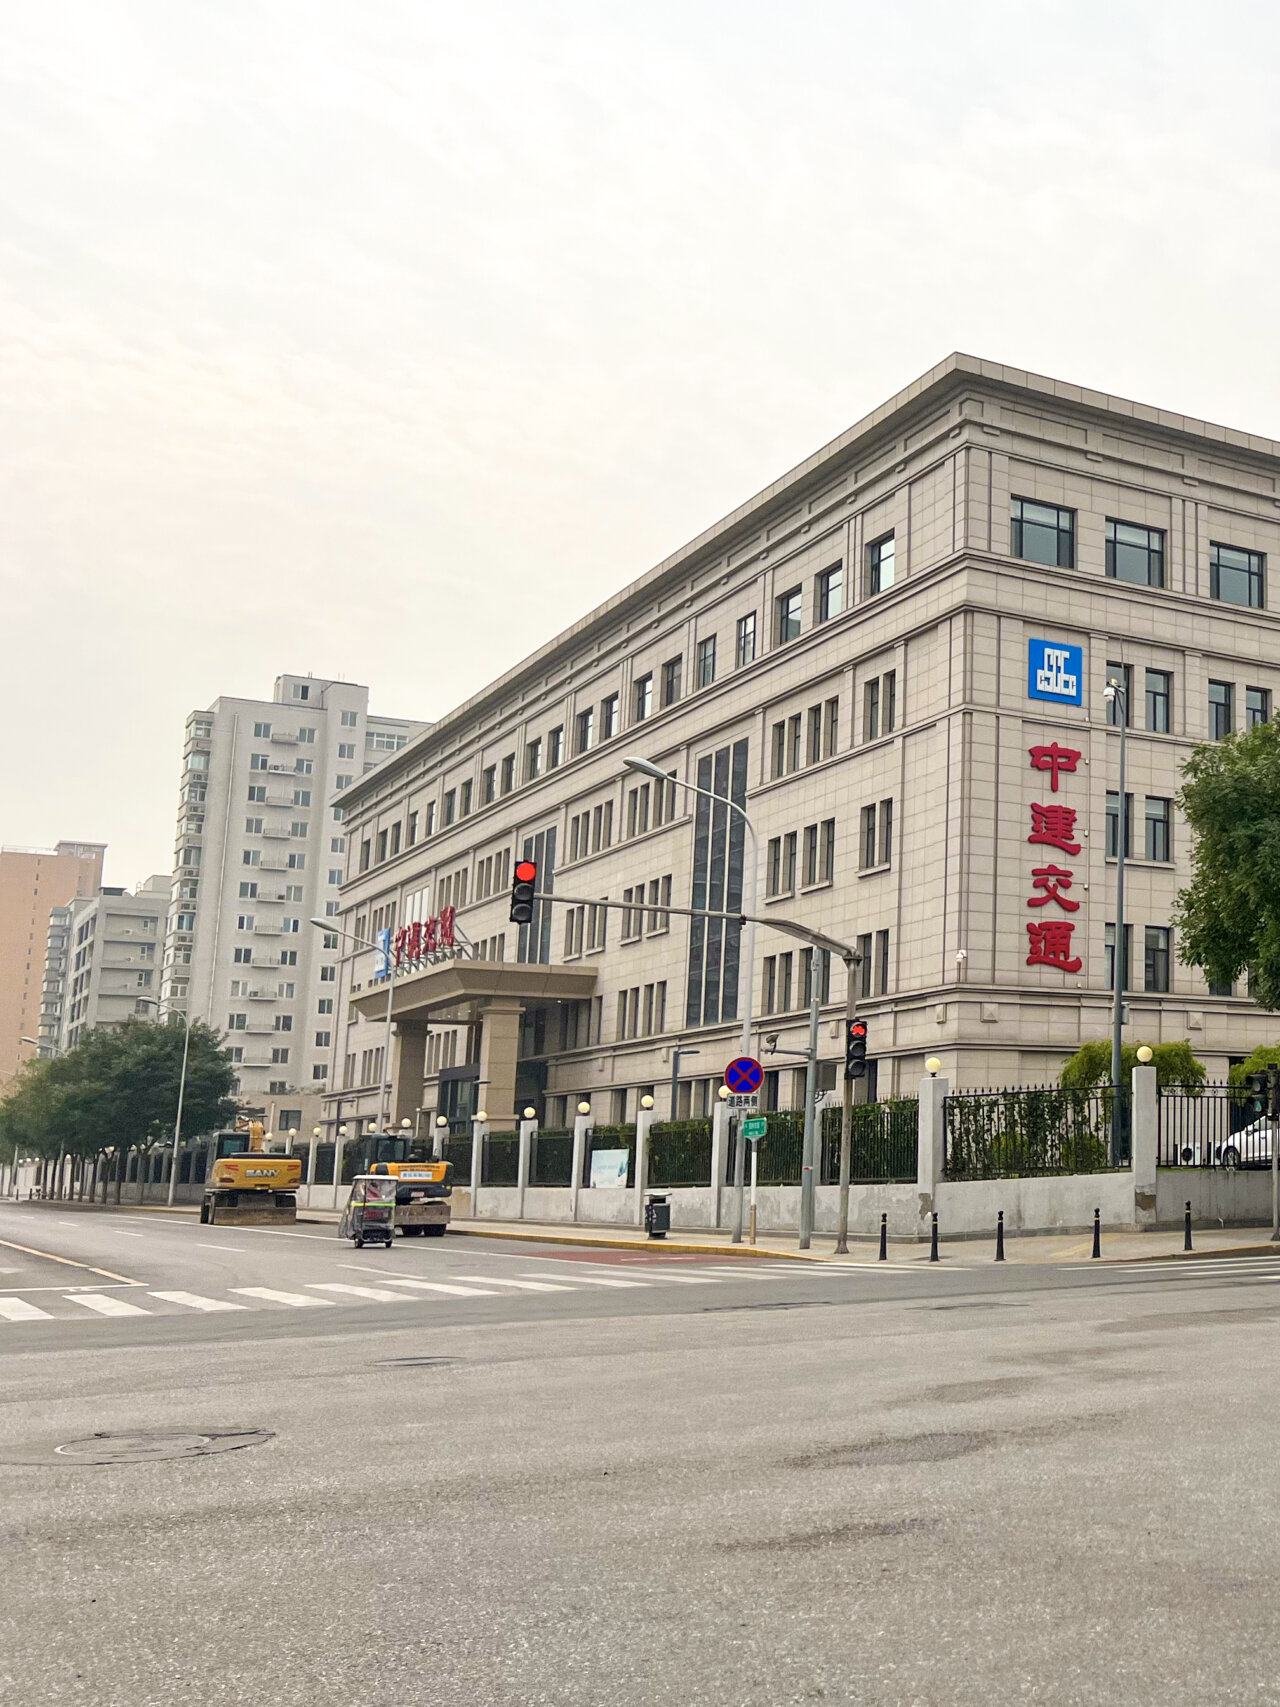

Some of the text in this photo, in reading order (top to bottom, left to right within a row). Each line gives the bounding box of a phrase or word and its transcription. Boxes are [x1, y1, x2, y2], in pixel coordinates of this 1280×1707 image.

[1026, 741, 1082, 973] 中建交通
[245, 1169, 280, 1177] SANY
